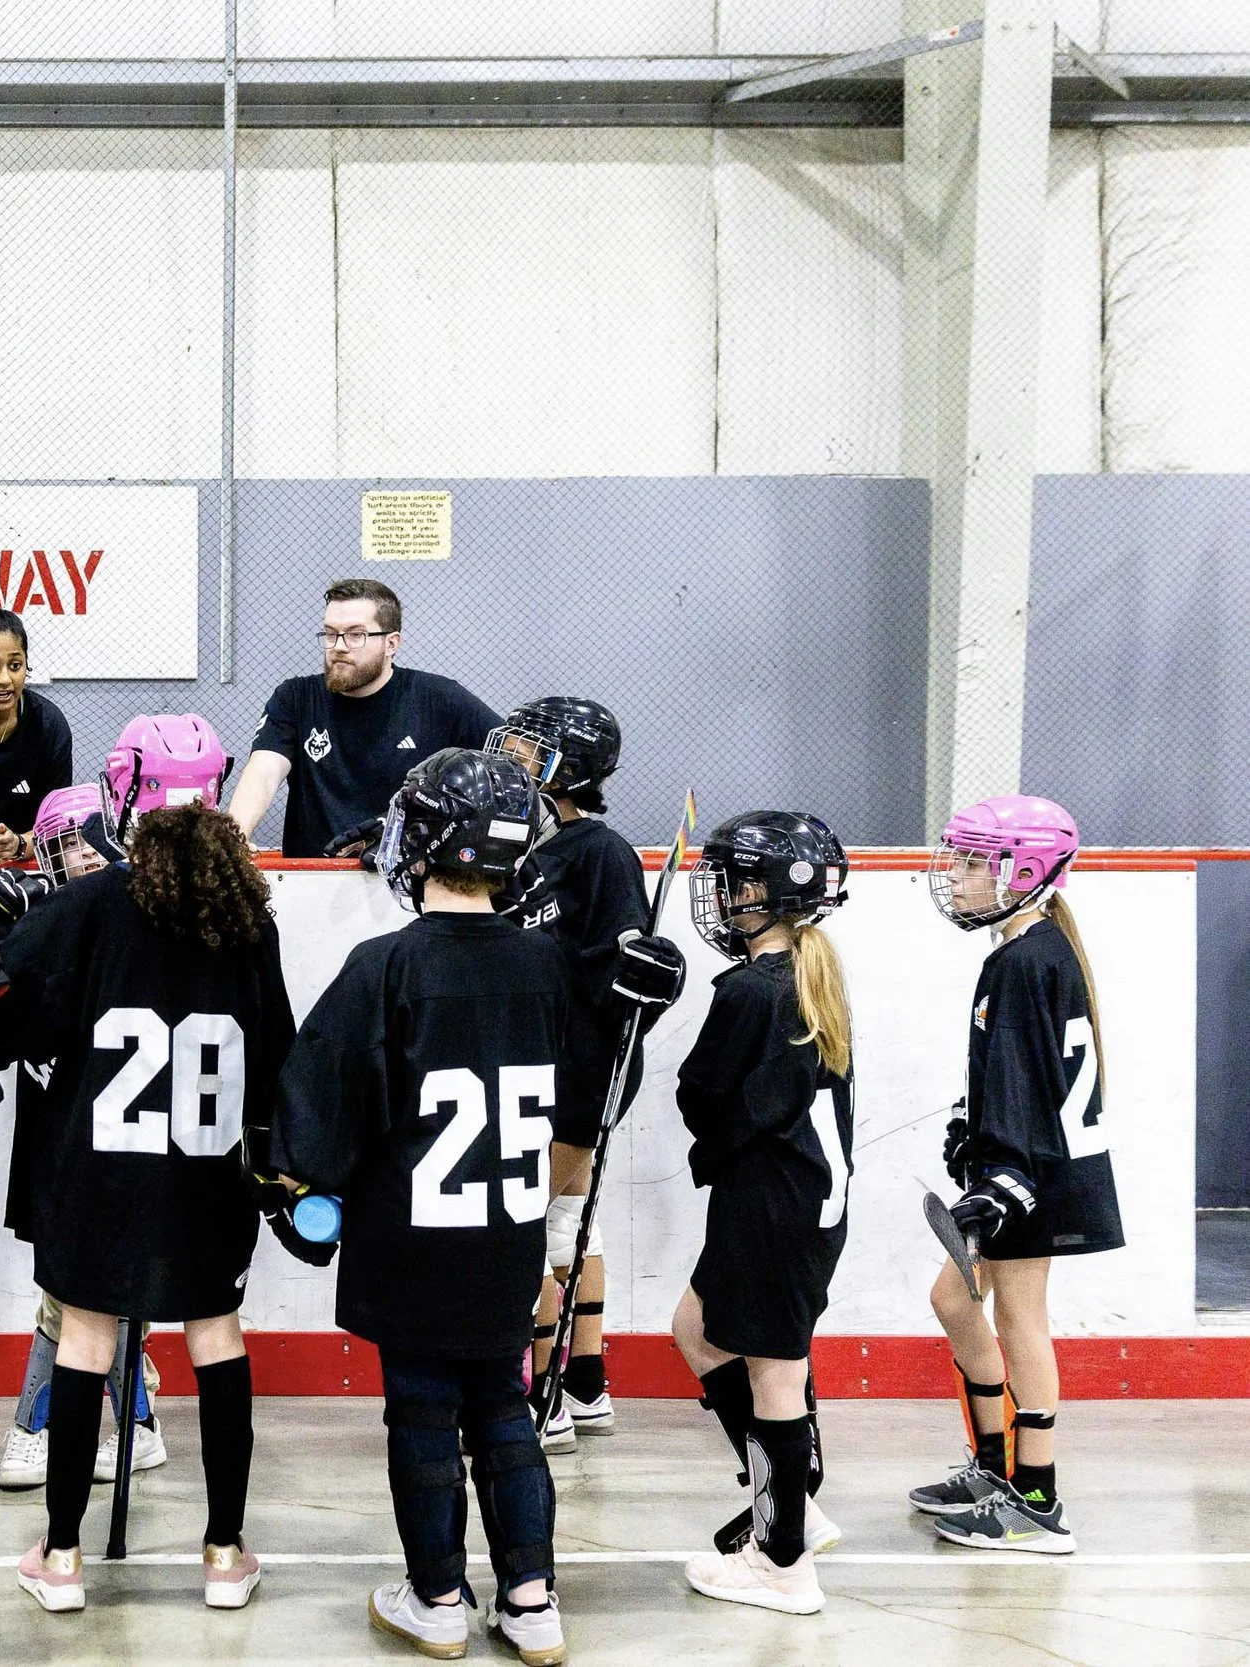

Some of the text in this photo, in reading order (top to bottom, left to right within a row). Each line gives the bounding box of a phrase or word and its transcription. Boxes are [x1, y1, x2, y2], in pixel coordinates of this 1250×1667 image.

[415, 790, 440, 810] BAUER
[733, 852, 760, 862] CCM
[742, 904, 763, 913] CCM
[92, 1007, 246, 1157] 28
[410, 1063, 556, 1228] 25
[808, 1087, 854, 1229] 1
